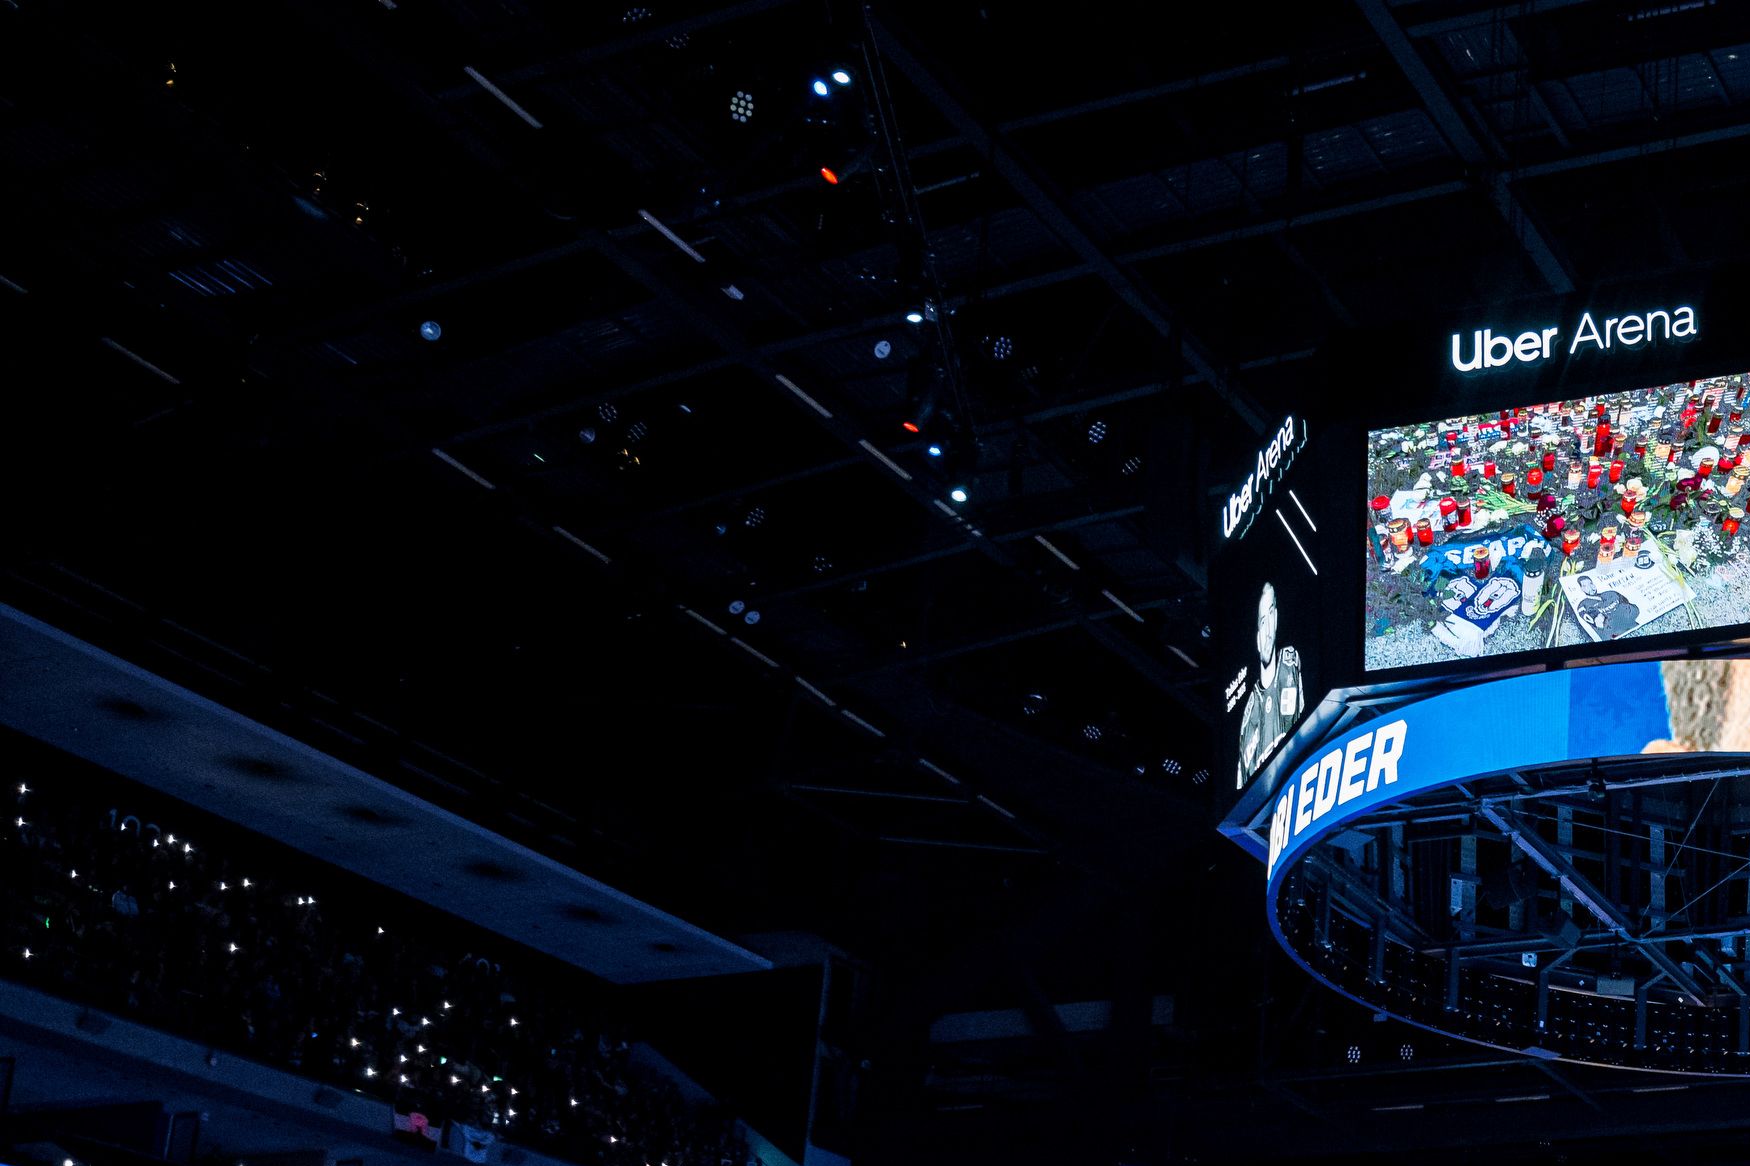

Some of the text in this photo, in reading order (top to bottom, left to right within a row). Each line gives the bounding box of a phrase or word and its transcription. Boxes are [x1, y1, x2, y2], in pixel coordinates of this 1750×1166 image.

[1452, 306, 1697, 372] Uber Arena
[1223, 416, 1294, 538] Uber Arena
[1294, 719, 1408, 836] EDER
